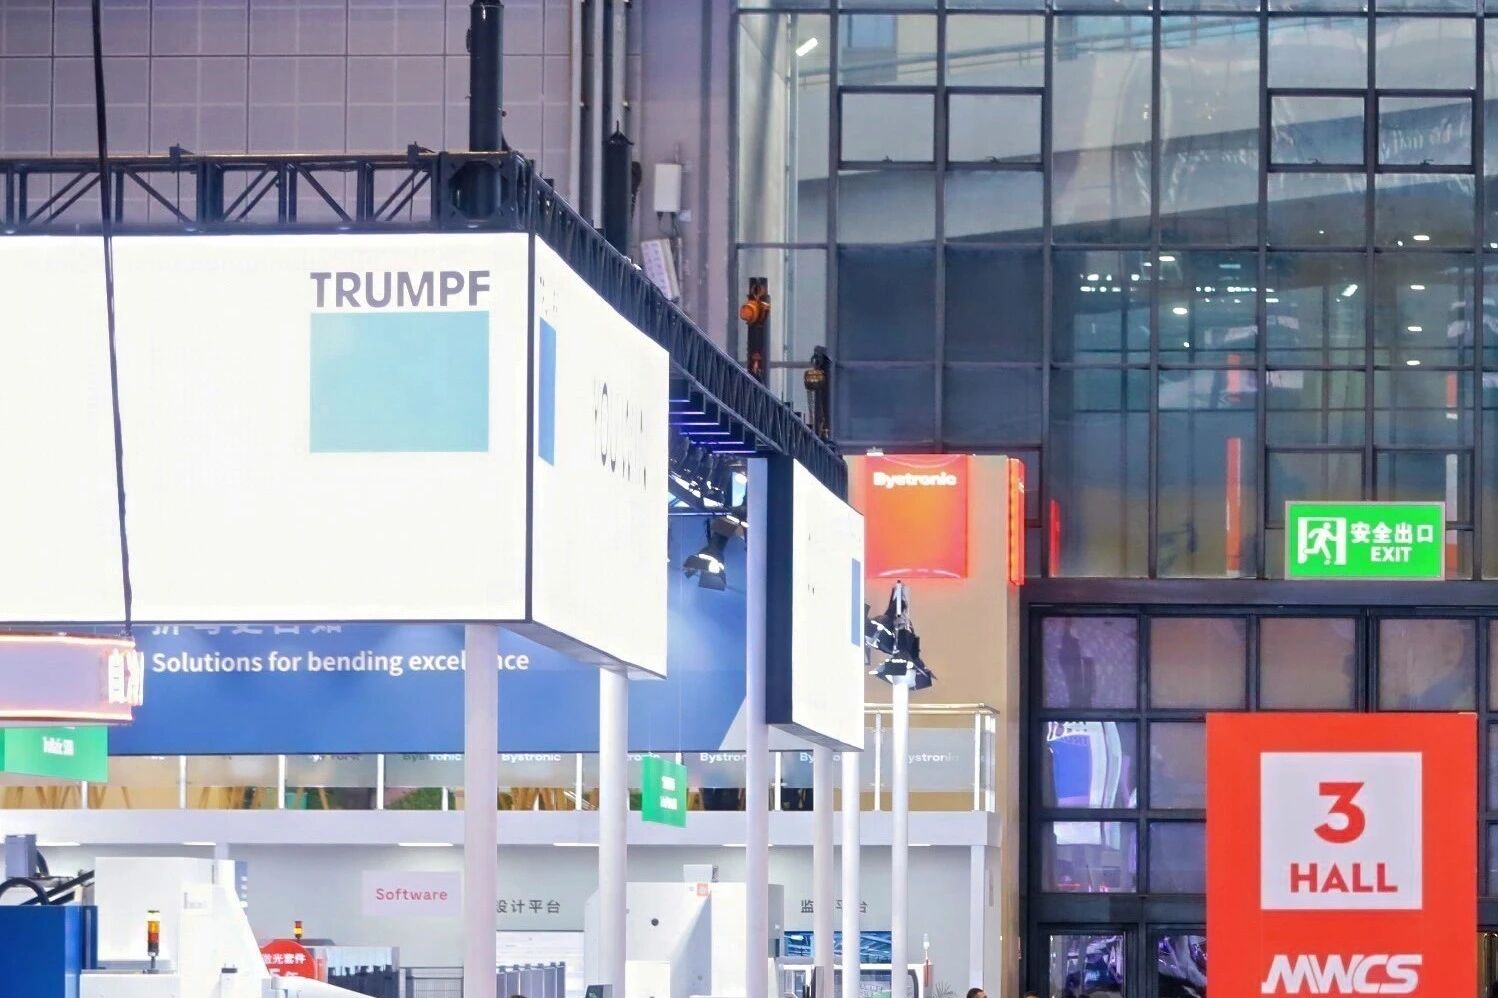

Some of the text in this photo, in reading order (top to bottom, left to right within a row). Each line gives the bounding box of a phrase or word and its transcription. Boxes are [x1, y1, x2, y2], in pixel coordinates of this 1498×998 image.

[310, 270, 490, 308] TRUMPF
[873, 472, 957, 489] Bystronic
[1351, 522, 1434, 544] 安全出口
[1371, 546, 1413, 563] EXIT
[152, 652, 263, 673] Solutions
[268, 651, 303, 672] for
[307, 651, 403, 677] bending
[1314, 782, 1366, 843] 3
[1290, 863, 1398, 893] HALL
[375, 888, 448, 901] Software
[1261, 954, 1423, 994] MWCS
